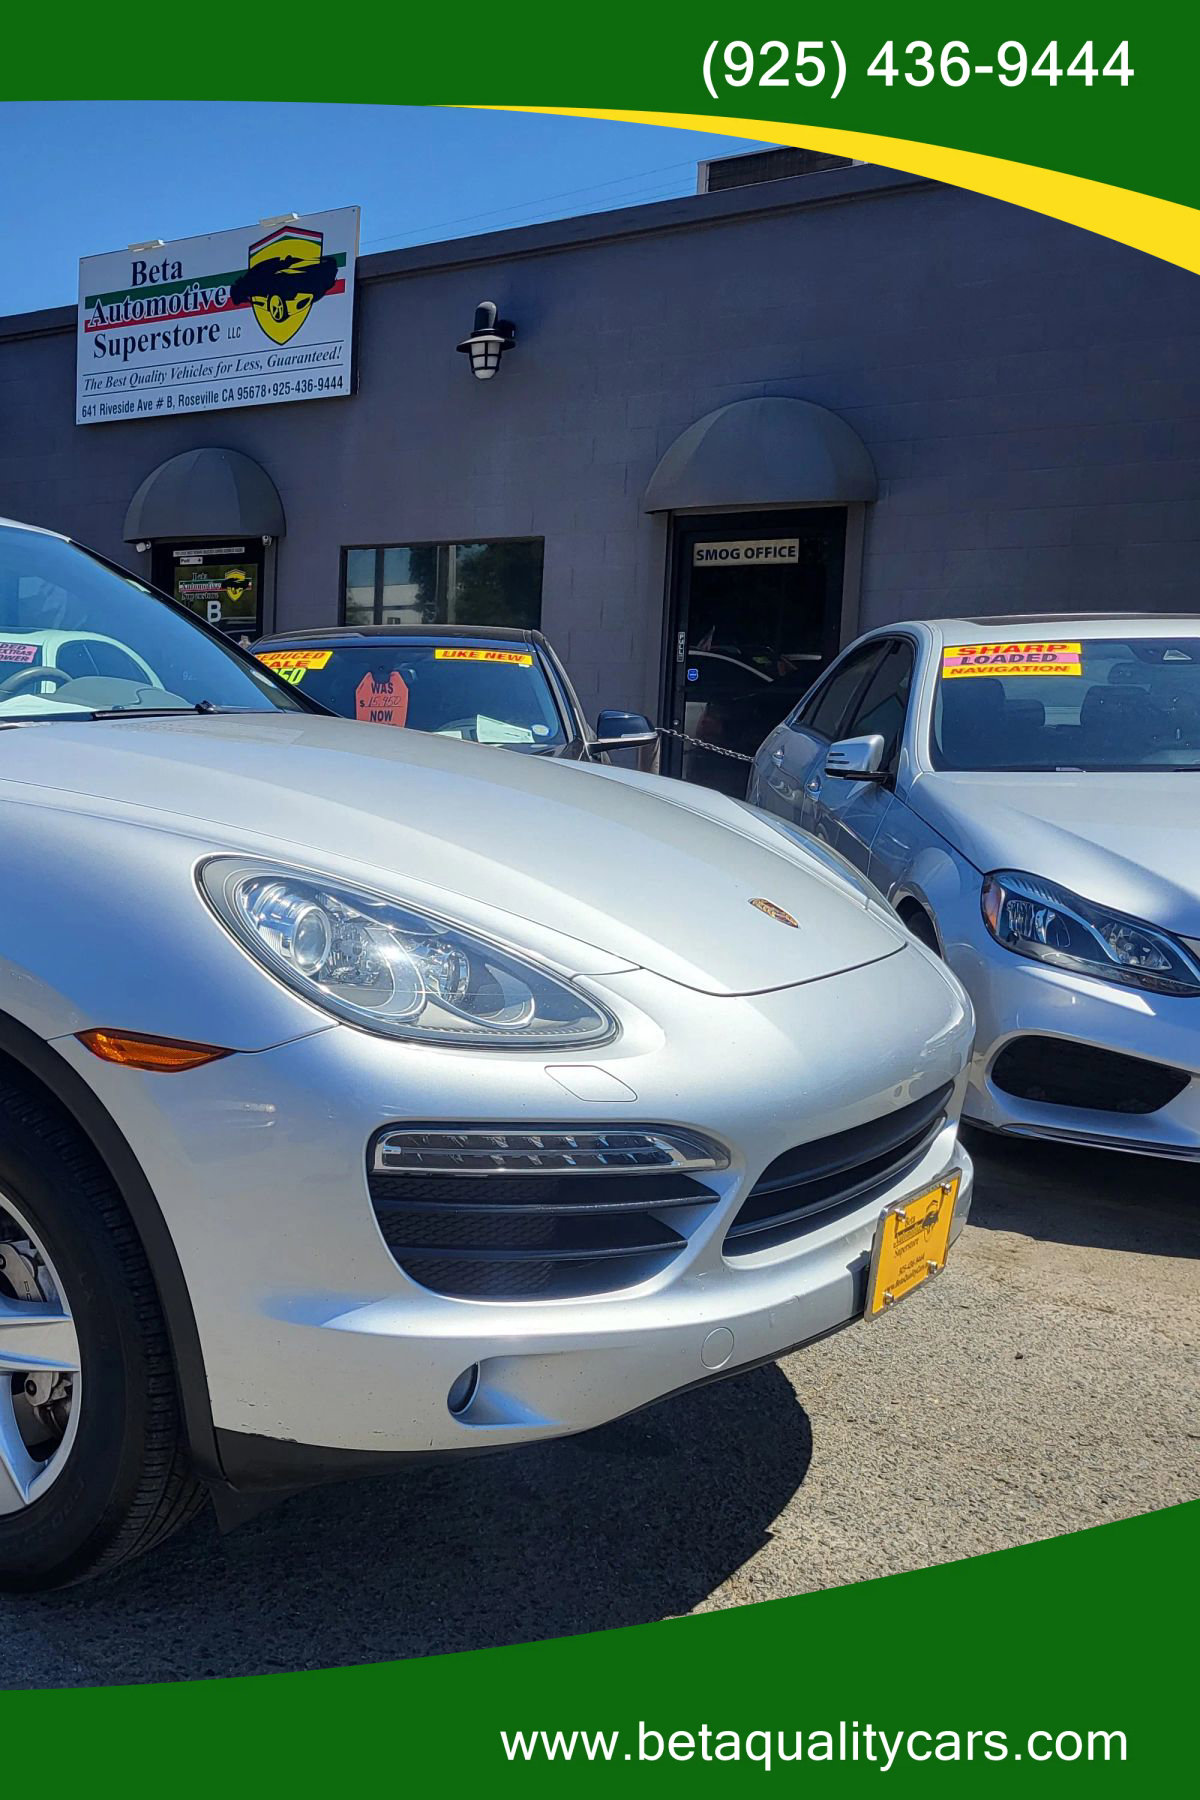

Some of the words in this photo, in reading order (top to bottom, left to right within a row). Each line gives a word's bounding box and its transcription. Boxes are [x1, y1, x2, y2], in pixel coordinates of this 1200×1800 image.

[131, 258, 183, 286] Beta
[89, 284, 227, 327] Automotive
[93, 323, 220, 362] Superstore
[227, 326, 241, 339] LLC
[84, 379, 102, 391] The
[105, 376, 126, 388] Best
[130, 369, 167, 388] Quality
[171, 364, 213, 380] Vehicles
[214, 362, 232, 378] for
[236, 359, 262, 372] Less,
[267, 346, 342, 368] Guaranteed!
[82, 404, 96, 418] 641
[100, 400, 135, 416] Riveside
[137, 399, 153, 412] Ave
[178, 391, 219, 407] Roseville
[221, 388, 234, 402] CA
[696, 548, 741, 561] SMOG
[743, 545, 796, 559] OFFICE
[207, 600, 222, 623] B
[442, 650, 480, 658] LIKE
[484, 652, 525, 661] NEW
[956, 644, 1069, 656] SHARP
[264, 660, 311, 668] ALE
[960, 653, 1058, 665] LOADED
[950, 664, 1070, 675] NAVIGATION
[371, 682, 394, 694] WAS
[370, 710, 393, 722] NOW
